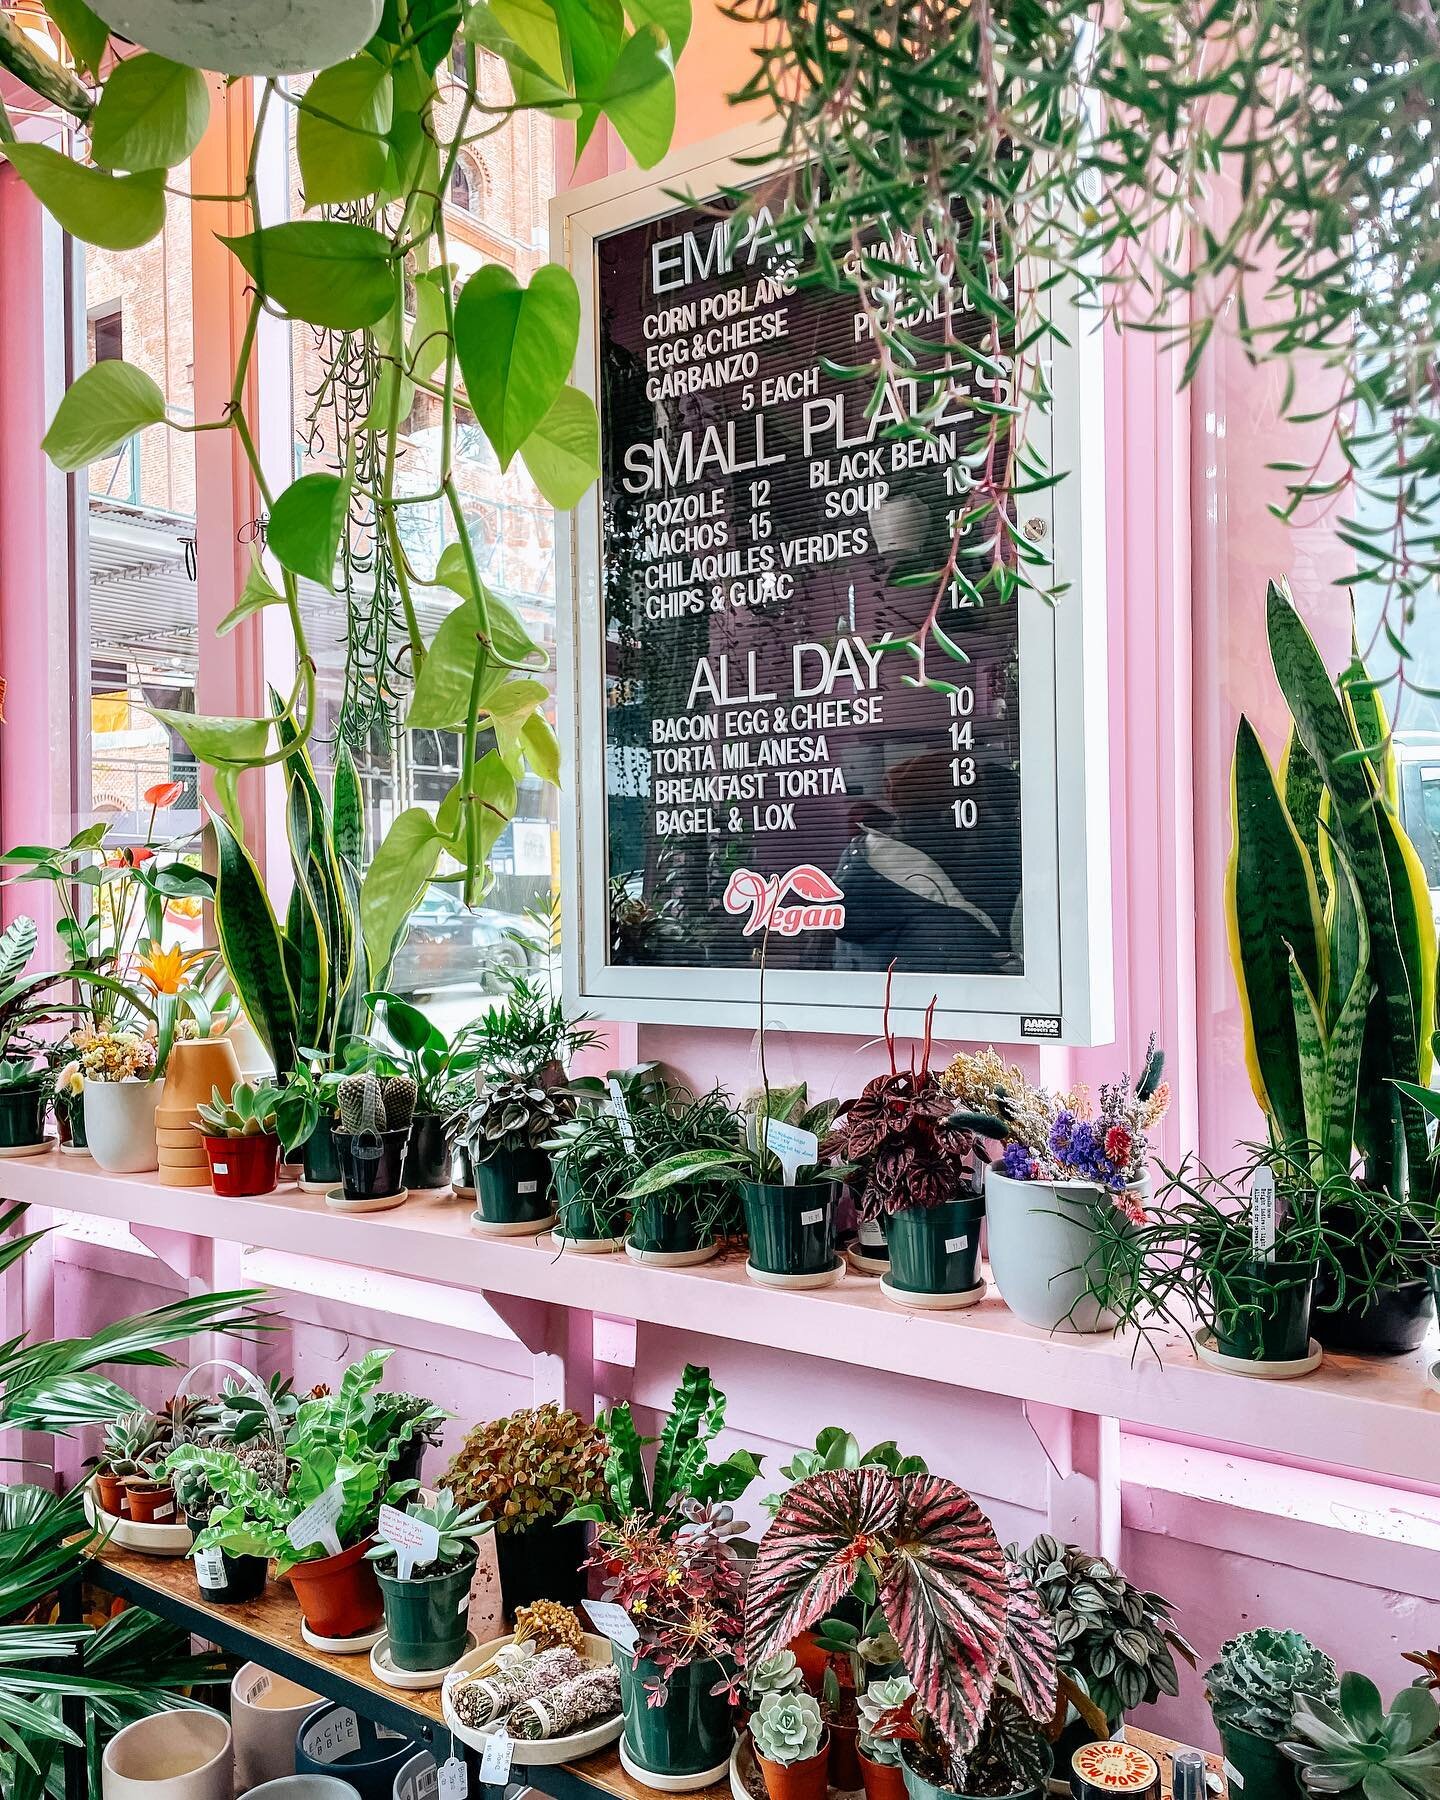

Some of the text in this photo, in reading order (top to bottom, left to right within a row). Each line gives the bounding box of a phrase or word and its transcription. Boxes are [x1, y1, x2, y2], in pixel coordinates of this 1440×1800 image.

[643, 267, 799, 341] CORN POBLANO
[645, 351, 760, 402] GARBANZO
[741, 365, 820, 412] 5 EACH
[622, 354, 1016, 494] SMALL PLATES
[809, 431, 957, 489] BLACK BEAN
[645, 480, 771, 530] POZOLE 12
[825, 481, 890, 519] SOUP
[644, 526, 869, 590] CHILAQUILES VERDES
[645, 511, 773, 560] NACHOS 15
[645, 572, 795, 622] CHIPS & GUAC
[686, 631, 895, 711] ALL DAY
[651, 712, 719, 745] BACON
[948, 685, 974, 717] 10
[653, 721, 975, 775] TORTA MILANESA 14
[654, 757, 976, 805] BREAKFAST TORTA 13
[654, 798, 978, 836] BAGEL & LOX 10
[725, 865, 844, 936] Vegan
